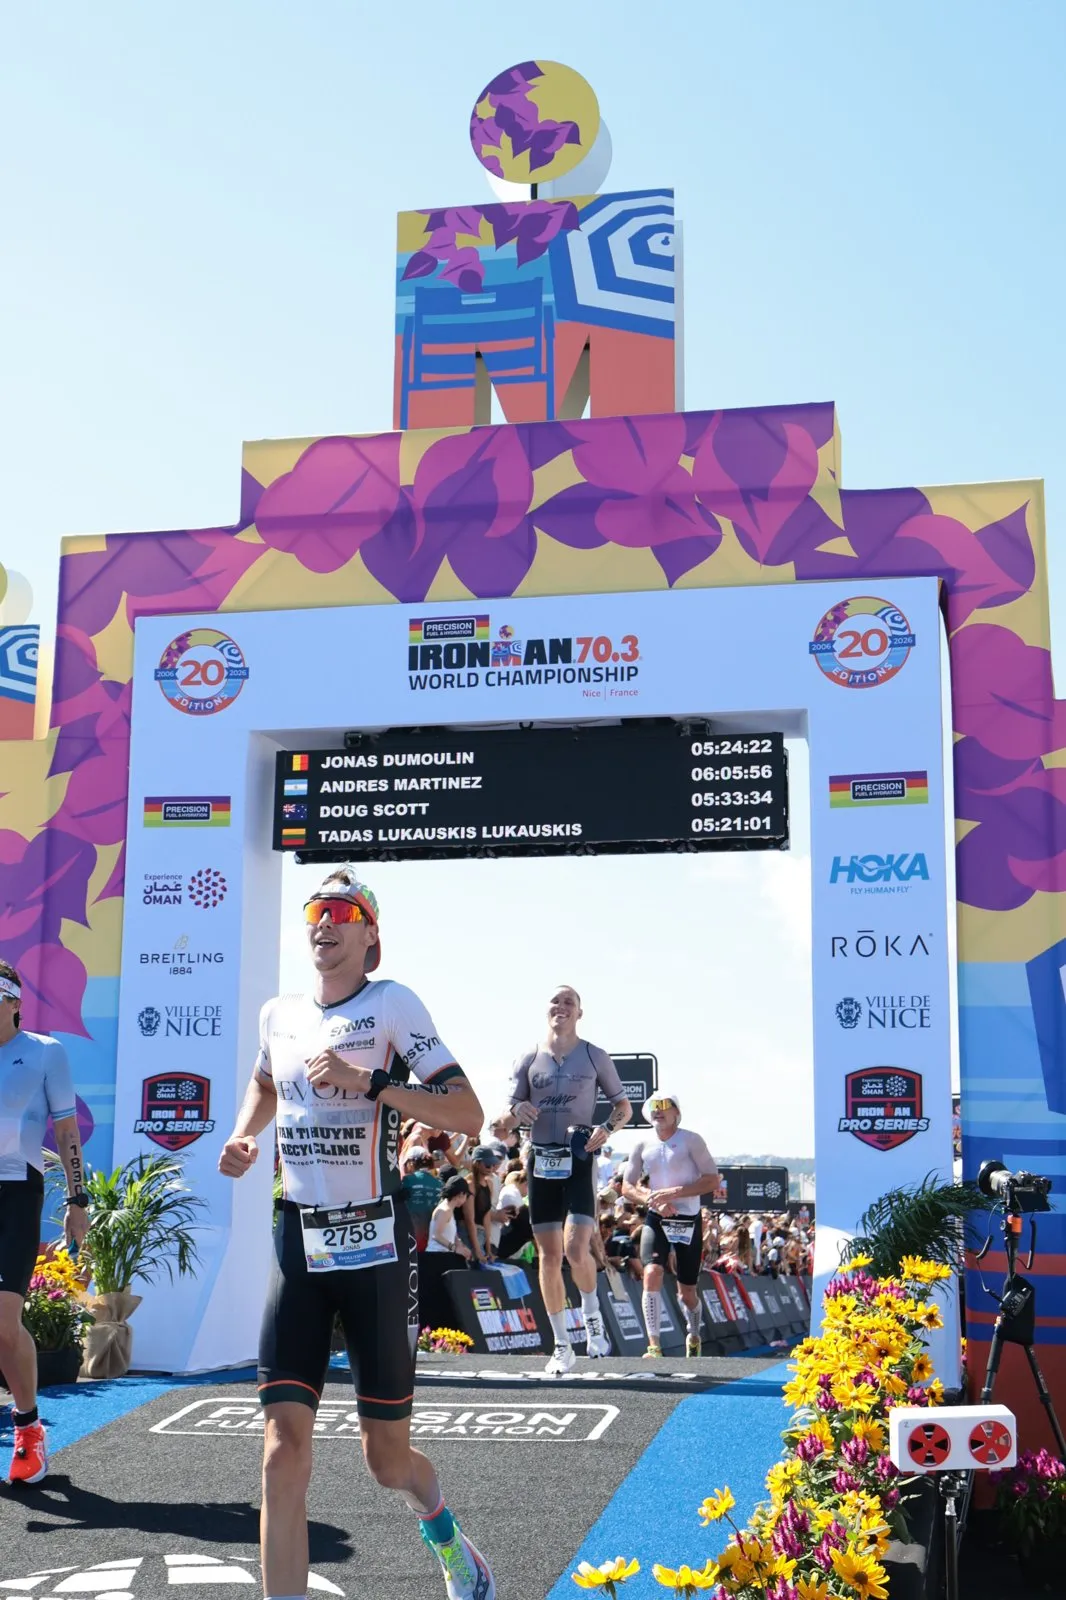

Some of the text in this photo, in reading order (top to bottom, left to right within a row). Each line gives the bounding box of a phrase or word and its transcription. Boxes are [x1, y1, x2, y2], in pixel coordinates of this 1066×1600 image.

[426, 622, 472, 631] PRECISION
[811, 643, 832, 651] 2006
[837, 628, 888, 658] 20
[893, 636, 913, 645] 2026
[576, 635, 639, 663] 70.3
[180, 659, 225, 686] 20
[408, 665, 639, 690] WORLD CHAMPIONSHIP
[831, 662, 893, 683] EDITIONS
[174, 691, 228, 710] EDITIONS
[582, 687, 639, 698] Nice France
[691, 739, 772, 756] 05:24:22
[320, 751, 475, 769] JONAS DUMOULIN
[691, 764, 773, 781] 06:05:56
[319, 776, 482, 793] ANDRES MARTINEZ
[854, 782, 902, 792] PRECISION
[691, 789, 773, 806] 05:33:34
[166, 805, 208, 813] PRECISION
[319, 802, 429, 818] DOUG SCOTT
[691, 816, 771, 832] 05:21:01
[318, 823, 582, 843] TADAS LUKAUSKIS LUKAUSKIS
[829, 852, 930, 884] HOKA
[144, 873, 182, 882] Experience
[850, 887, 864, 895] FLY
[864, 886, 895, 895] HUMAN
[142, 894, 182, 905] OMAN
[139, 952, 224, 964] BREITLING
[169, 966, 193, 975] 1884
[865, 995, 931, 1008] VILLE DE
[164, 1005, 222, 1017] VILLE DE
[867, 1008, 931, 1029] NICE
[165, 1017, 222, 1037] NICE
[135, 1120, 214, 1132] PRO SERIES
[839, 1118, 929, 1131] PRO SERIES
[322, 1222, 377, 1247] 2758
